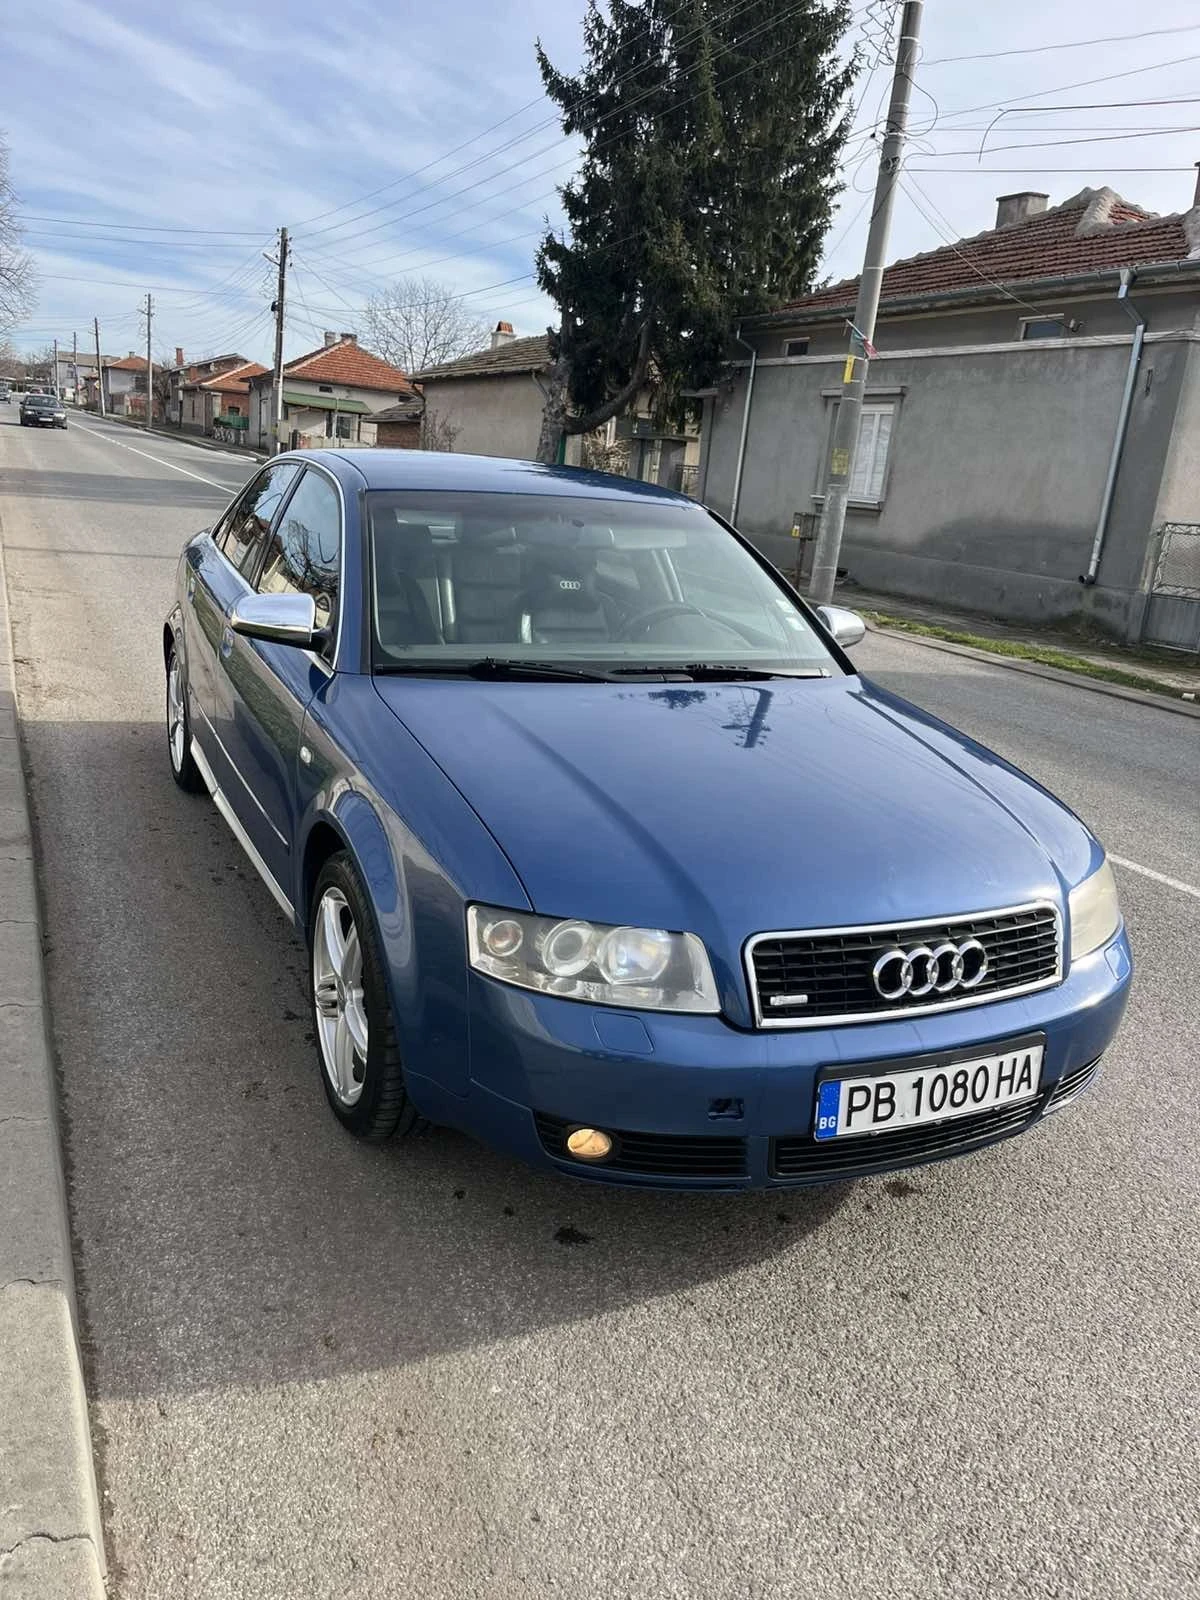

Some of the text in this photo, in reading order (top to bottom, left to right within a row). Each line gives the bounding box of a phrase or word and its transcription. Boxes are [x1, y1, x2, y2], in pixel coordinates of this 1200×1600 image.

[846, 1054, 1032, 1127] PB 1080 HA
[819, 1115, 837, 1130] BG
